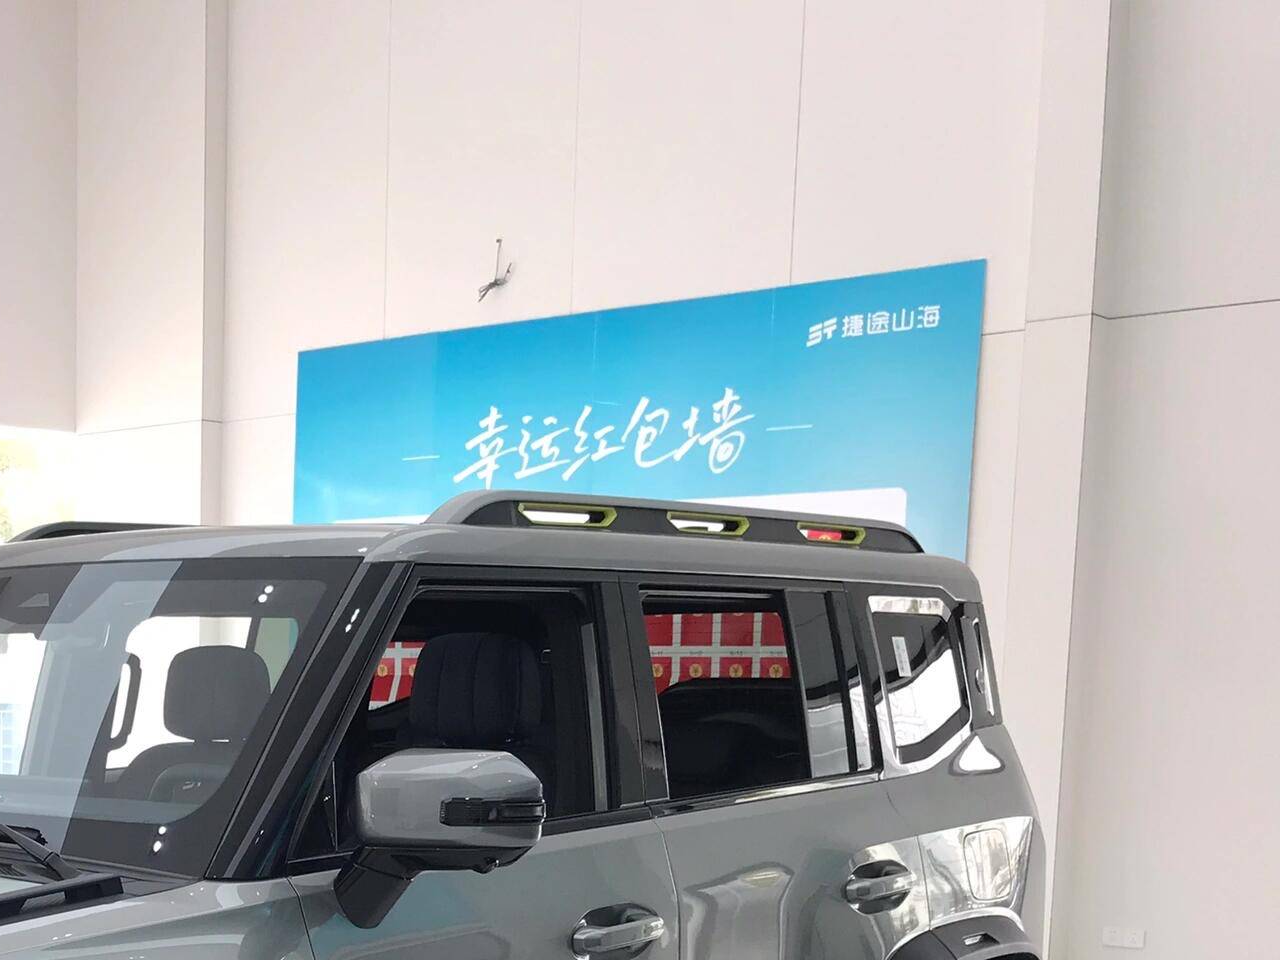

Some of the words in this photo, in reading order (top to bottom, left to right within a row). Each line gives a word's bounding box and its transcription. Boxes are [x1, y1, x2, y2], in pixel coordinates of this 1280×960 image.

[841, 304, 941, 338] 捷途山海
[453, 387, 756, 490] 幸运红包墙
